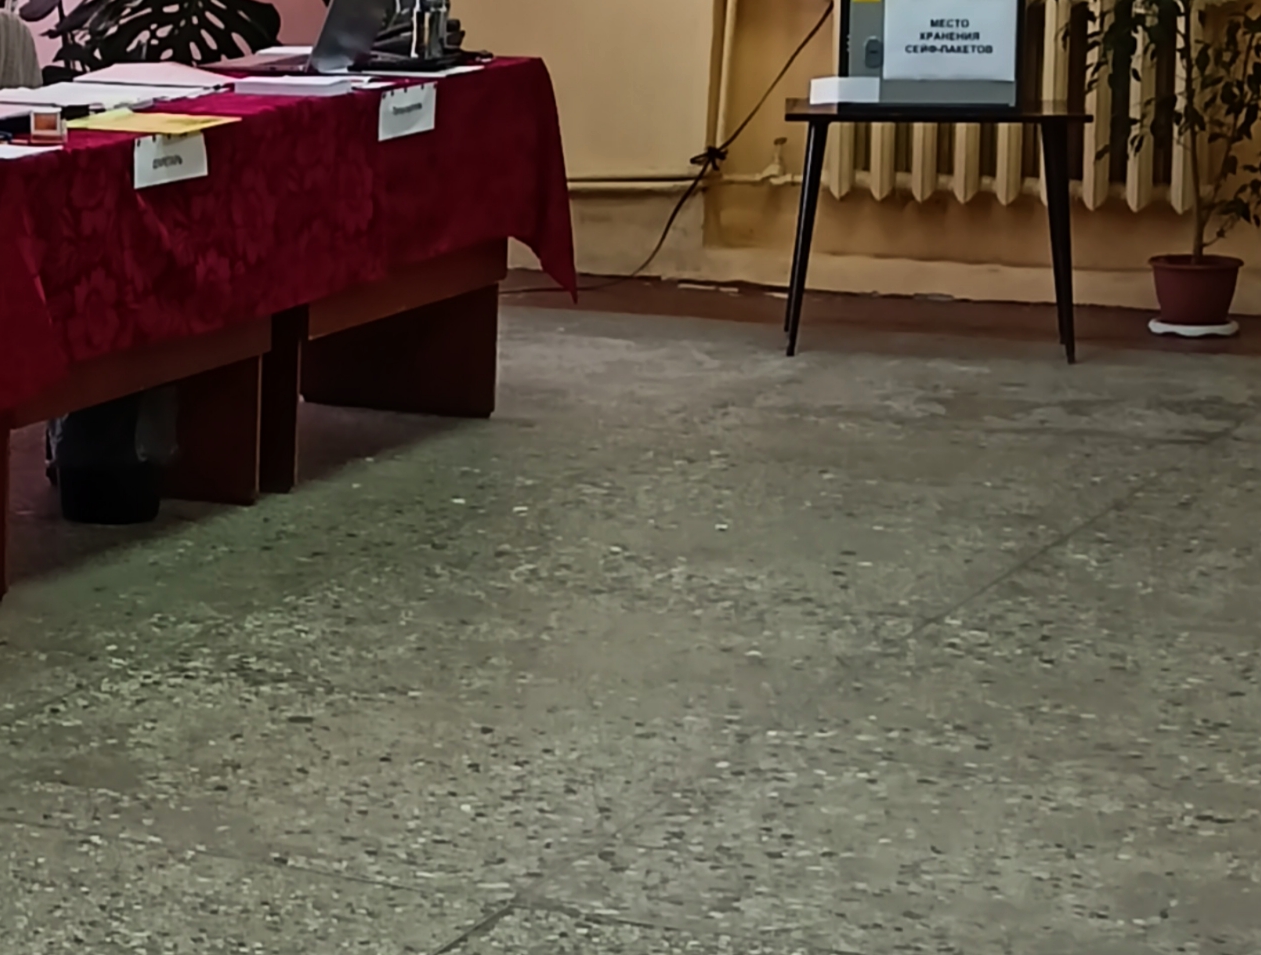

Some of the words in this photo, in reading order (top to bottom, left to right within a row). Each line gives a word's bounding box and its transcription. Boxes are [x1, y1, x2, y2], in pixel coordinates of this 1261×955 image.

[930, 19, 969, 28] МЕСТО
[919, 32, 979, 41] ХРАНЕНИЯ
[905, 44, 993, 54] СЕЙФ-ПАКЕТОВ
